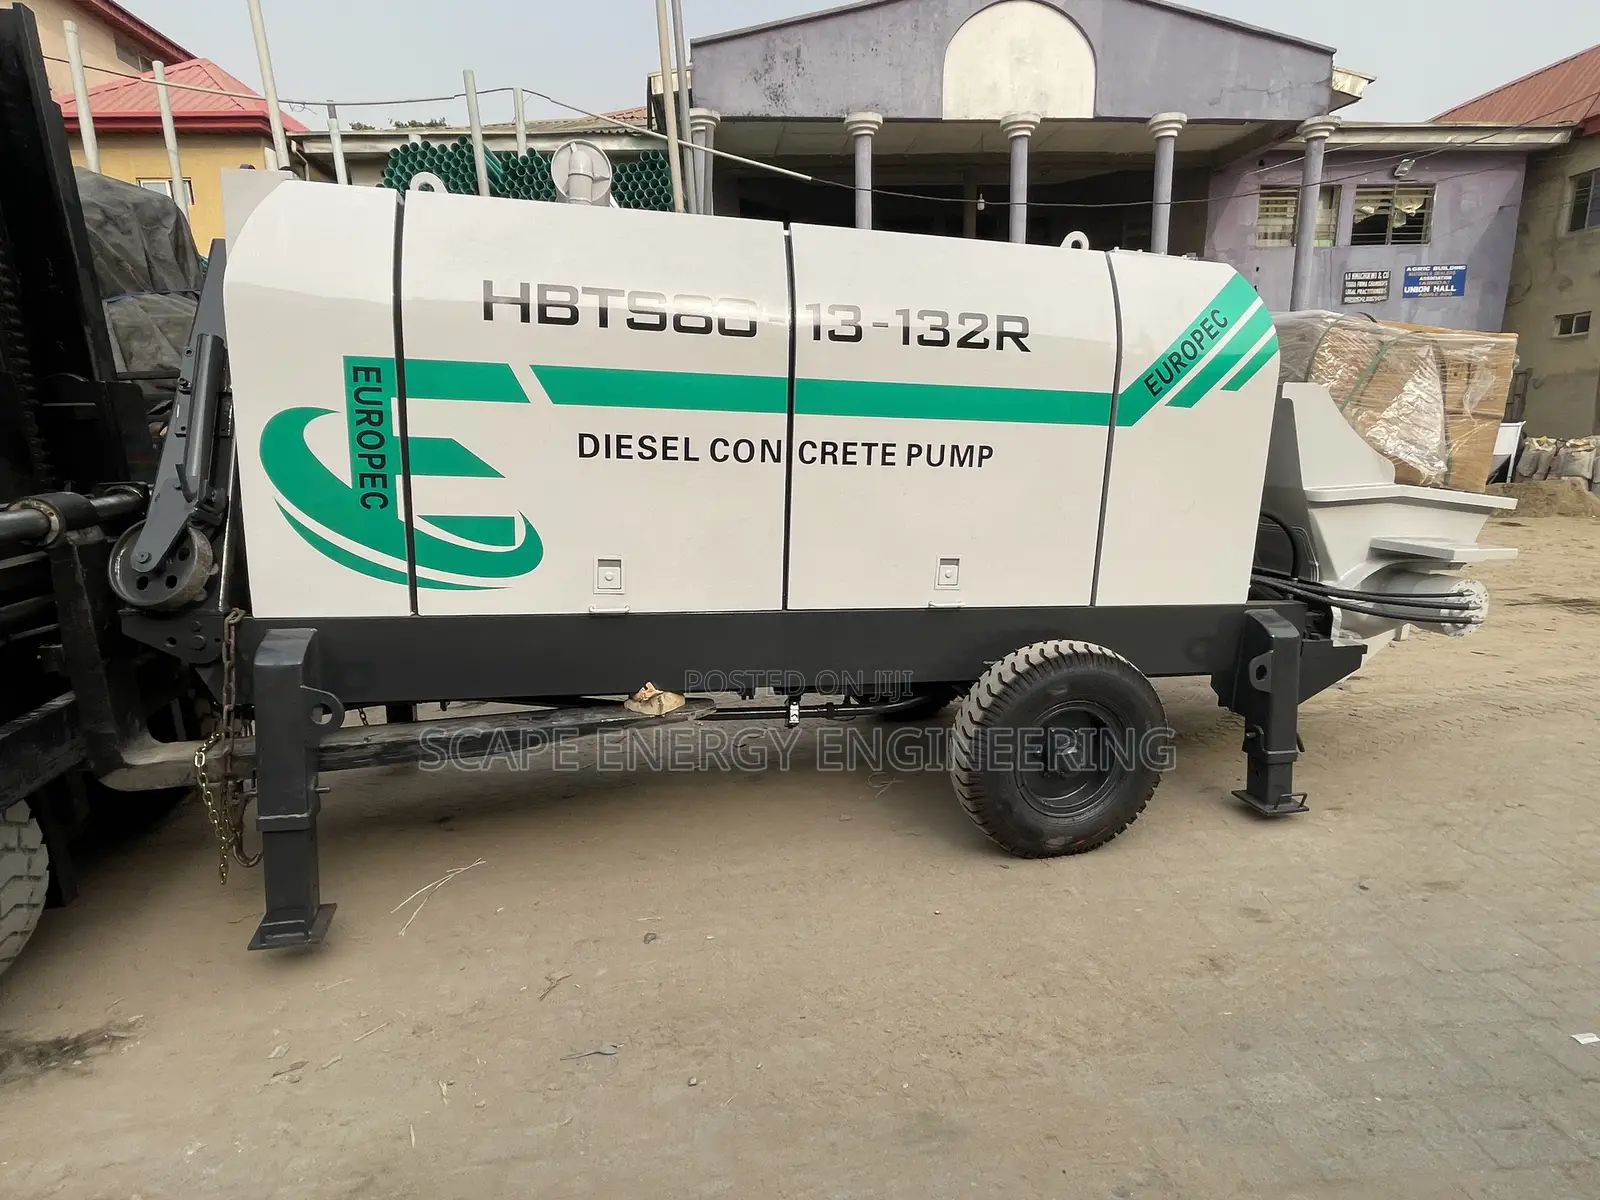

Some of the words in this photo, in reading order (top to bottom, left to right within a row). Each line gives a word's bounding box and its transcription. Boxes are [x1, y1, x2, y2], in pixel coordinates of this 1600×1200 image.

[1403, 285, 1431, 294] UNION
[1433, 284, 1457, 292] HALL
[1143, 308, 1229, 397] EUROPEC
[351, 365, 389, 511] EUROPEC
[577, 432, 699, 463] DIESEL
[906, 442, 994, 468] PUMP
